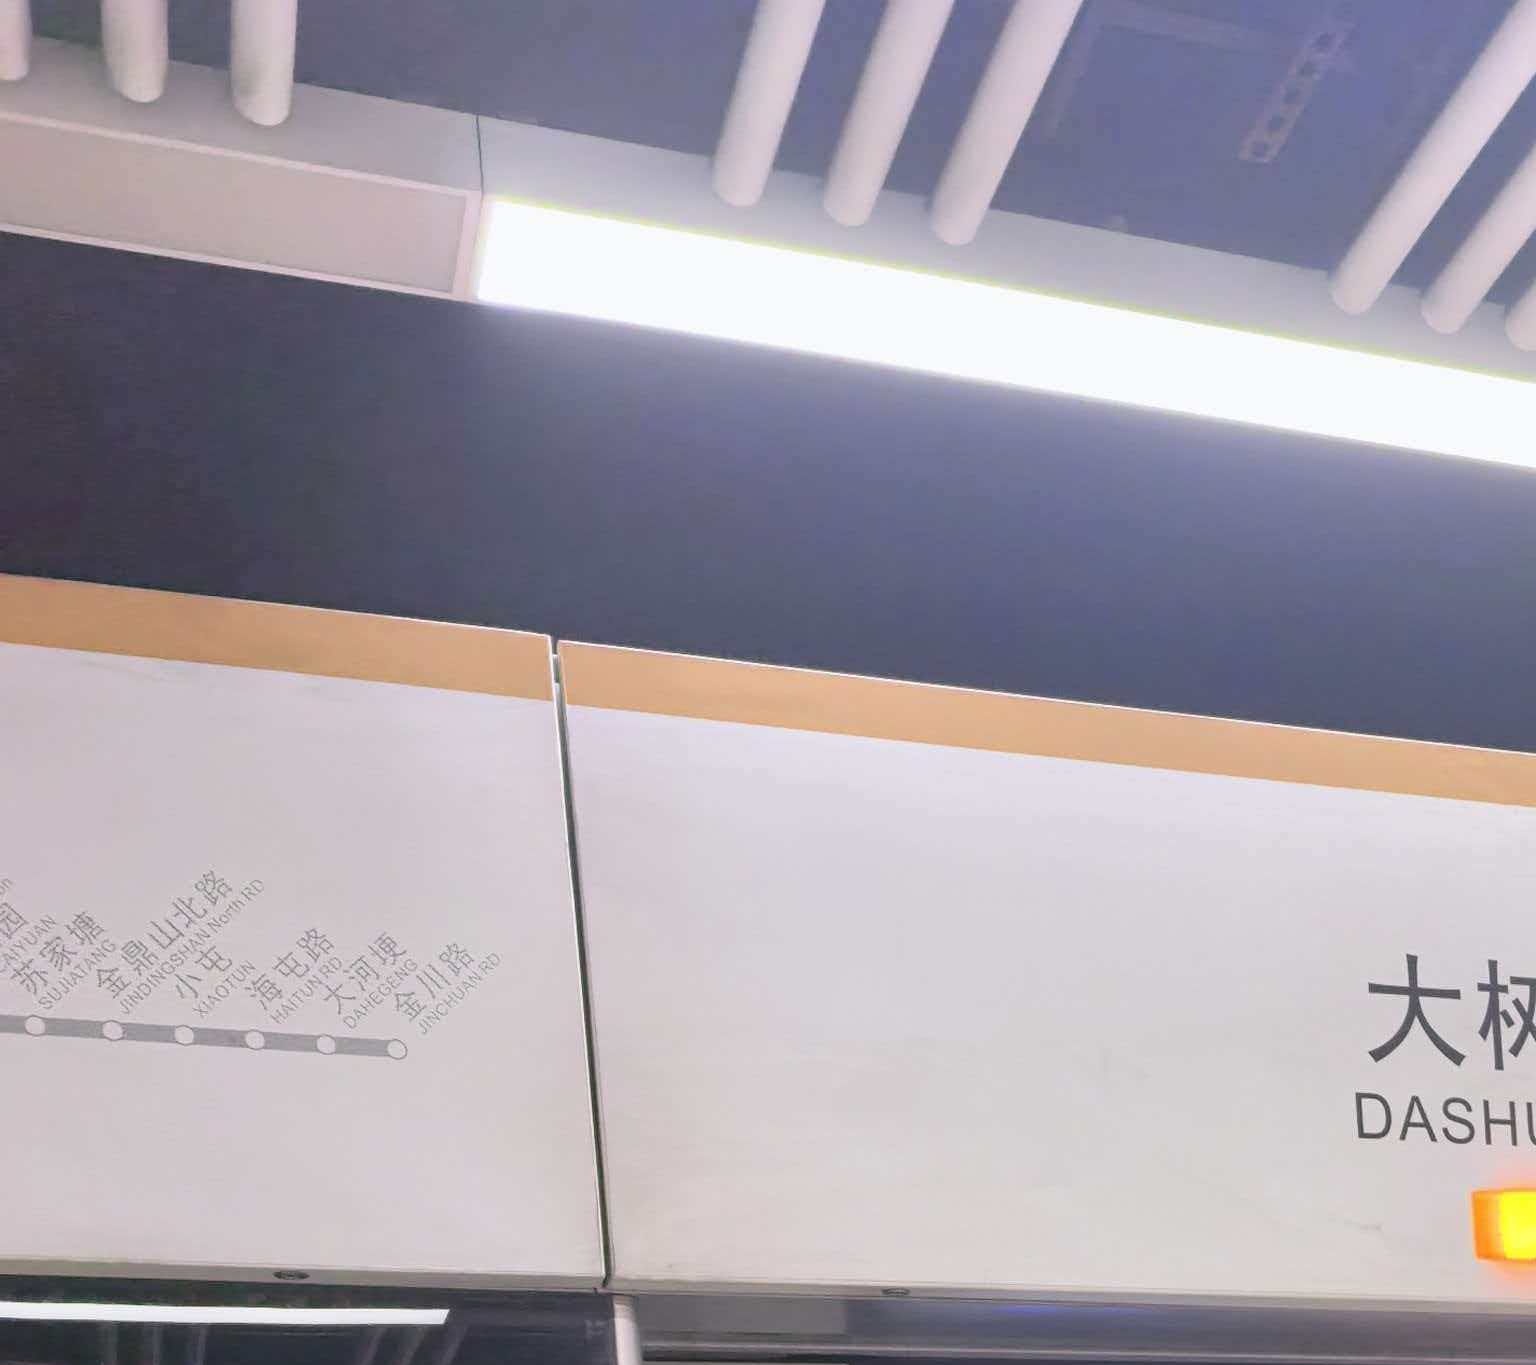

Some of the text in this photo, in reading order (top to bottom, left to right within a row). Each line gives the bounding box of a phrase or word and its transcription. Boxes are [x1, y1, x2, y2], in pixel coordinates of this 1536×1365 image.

[10, 911, 105, 995] 苏家塘
[38, 938, 117, 1011] SUJIATANG
[96, 870, 232, 999] 金鼎山北路
[119, 880, 265, 1015] JINDINGSHAN North RD
[175, 945, 232, 1000] 小屯
[244, 927, 334, 1010] 海屯路
[324, 931, 408, 1015] 大河埂
[192, 959, 256, 1019] XIAOTUN
[269, 956, 345, 1025] HAITUN RD
[343, 958, 419, 1030] DAHEGENG
[394, 941, 476, 1022] 金川路
[418, 952, 503, 1035] JINCHUAN RD
